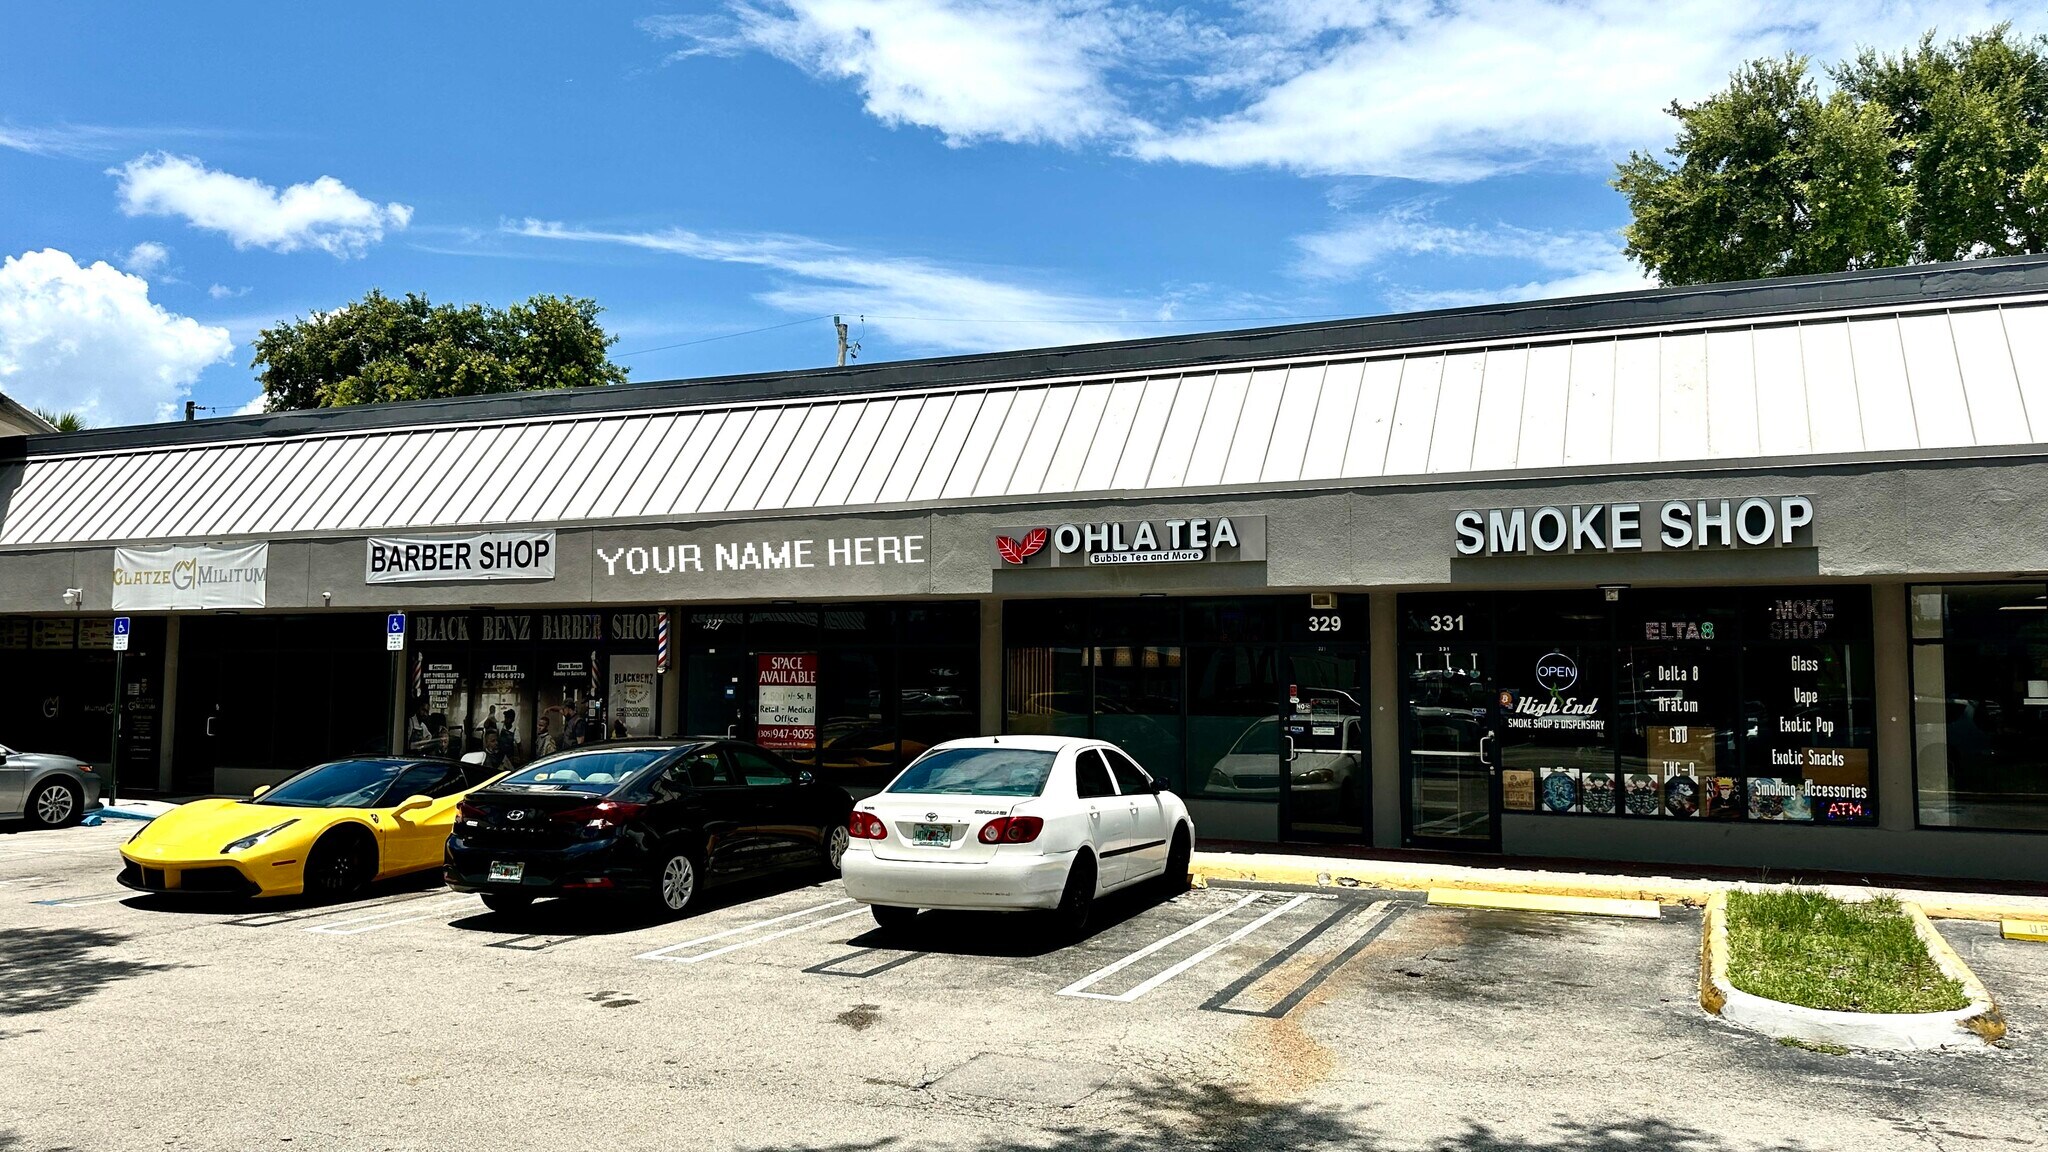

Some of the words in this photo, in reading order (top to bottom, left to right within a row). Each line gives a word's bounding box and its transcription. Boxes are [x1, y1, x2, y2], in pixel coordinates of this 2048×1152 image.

[1454, 503, 1643, 555] SMOKE
[1660, 495, 1814, 548] SHOP
[1053, 520, 1157, 553] OHLA
[1165, 516, 1239, 551] TEA
[371, 543, 472, 573] BARBER
[479, 540, 550, 569] SHOP
[597, 545, 704, 576] YOUR
[715, 540, 815, 571] NAME
[828, 535, 925, 566] HERE
[1094, 554, 1127, 563] Bubble
[1130, 553, 1148, 561] Tea
[1151, 552, 1169, 560] and
[1172, 551, 1199, 560] More
[415, 616, 469, 642] BLACK
[482, 615, 531, 641] BENZ
[542, 614, 601, 641] BARBER
[612, 613, 658, 640] SHOP
[703, 618, 724, 630] 327
[1308, 616, 1341, 632] 329
[1430, 615, 1465, 631] 331
[1768, 620, 1827, 640] SHOP
[771, 657, 803, 670] SPACE
[1538, 666, 1575, 677] OPEN
[1791, 655, 1819, 672] Glass
[759, 671, 817, 684] AVAILABLE
[1658, 665, 1687, 681] Delta
[1692, 665, 1699, 681] 8
[1658, 697, 1698, 712] Kratom
[1794, 687, 1818, 707] Vape
[760, 705, 780, 713] Retail
[788, 705, 815, 714] Medical
[1515, 696, 1560, 717] High
[1562, 697, 1599, 715] End
[774, 714, 799, 724] Office
[1508, 718, 1532, 728] SMOKE
[1533, 718, 1553, 729] SHOP
[1554, 720, 1560, 729] &
[1561, 719, 1605, 730] DISPENSARY
[1780, 716, 1812, 733] Exotic
[1816, 716, 1834, 737] Pop
[1669, 727, 1688, 743] CBD
[1771, 749, 1804, 766] Exotic
[1808, 749, 1845, 767] Snacks
[1755, 780, 1796, 800] Smoking
[1803, 780, 1868, 799] Accessories
[1828, 802, 1862, 817] ATM
